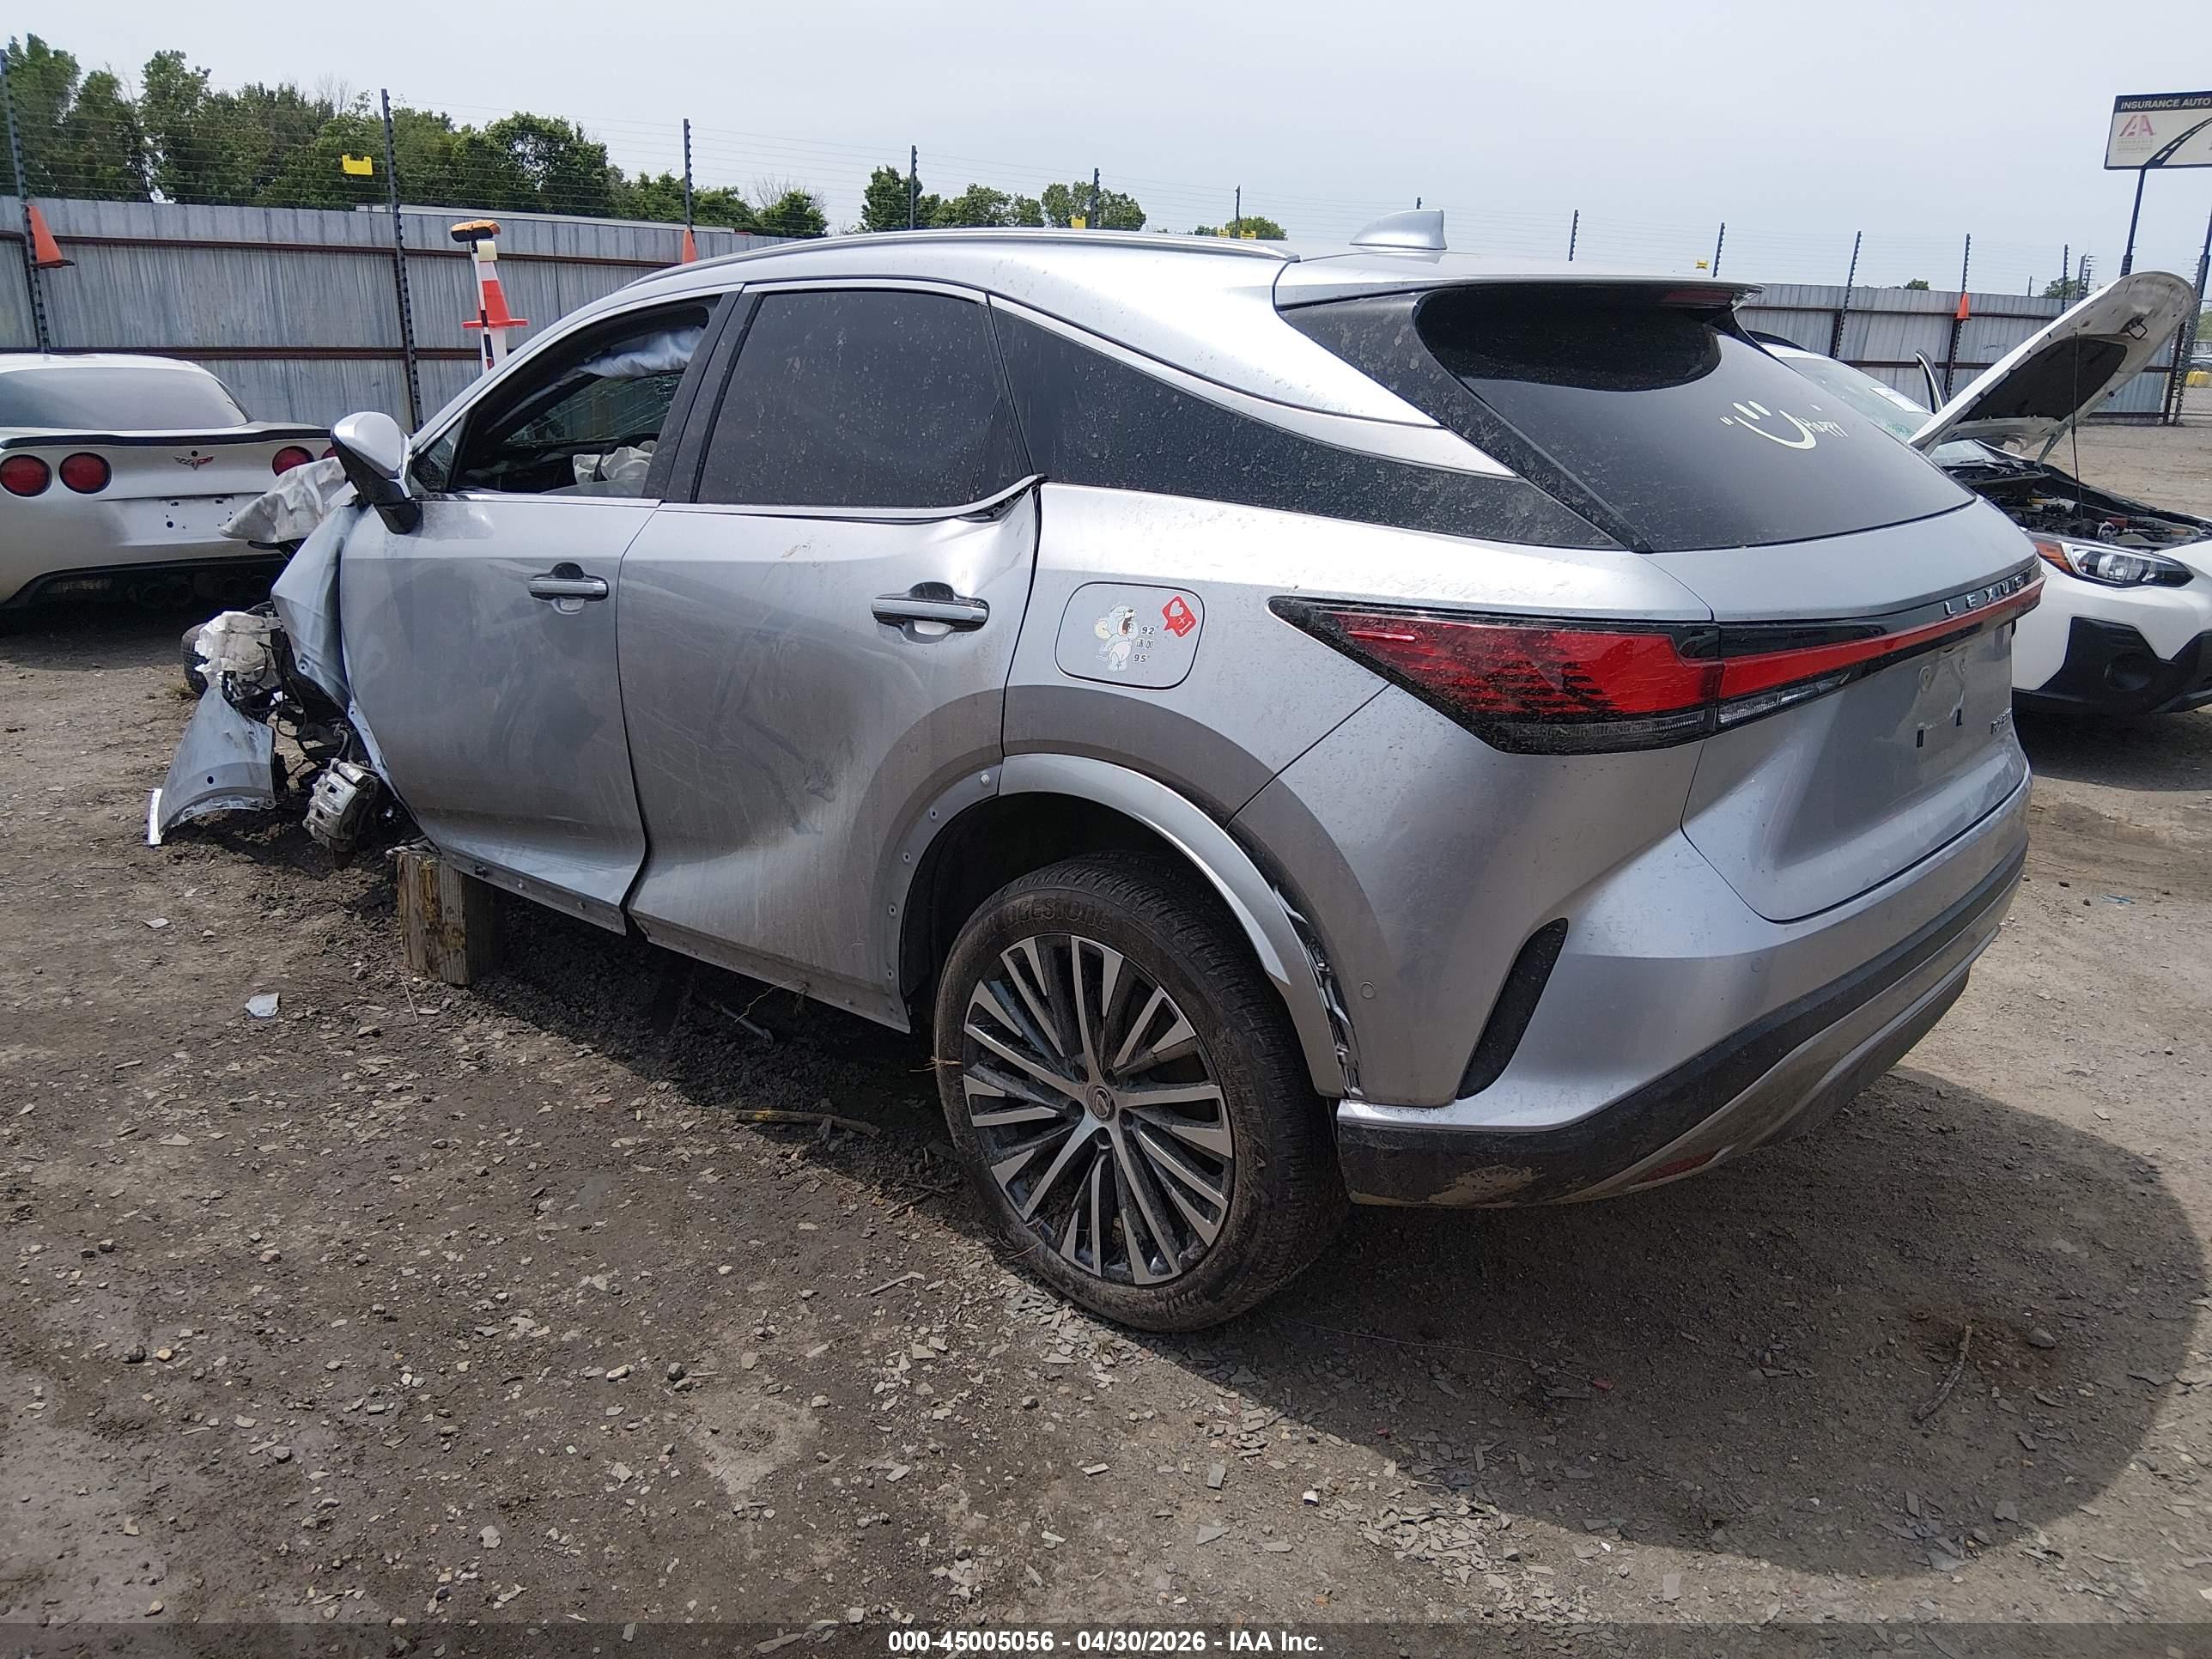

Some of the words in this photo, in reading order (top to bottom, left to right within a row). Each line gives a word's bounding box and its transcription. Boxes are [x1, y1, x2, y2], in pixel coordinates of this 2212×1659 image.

[2120, 98, 2179, 110] INSURANCE
[2181, 97, 2211, 106] AUTO
[1944, 575, 2024, 616] LEXUS
[1141, 626, 1155, 635] 92
[1133, 653, 1147, 663] 95
